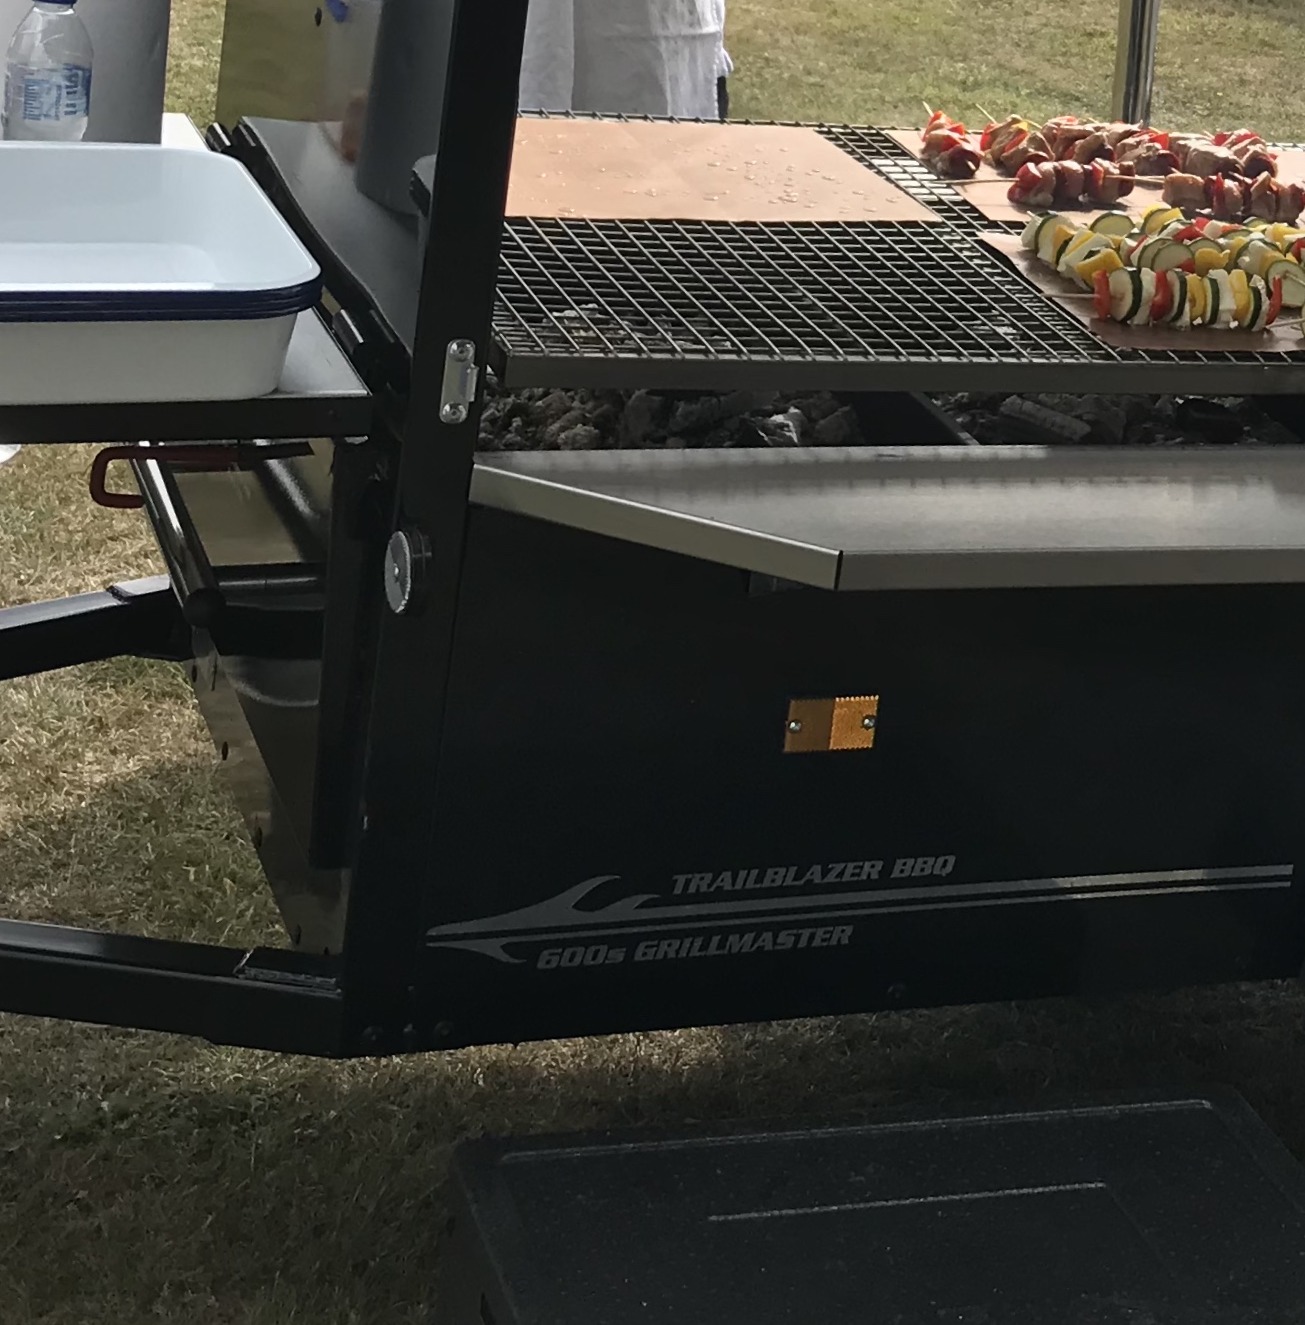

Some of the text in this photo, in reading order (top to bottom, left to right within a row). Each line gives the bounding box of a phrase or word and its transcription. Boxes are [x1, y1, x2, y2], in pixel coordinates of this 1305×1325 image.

[671, 855, 956, 895] TRAILBLAZER BBQ
[536, 925, 854, 969] 600s GRILLMASTER
